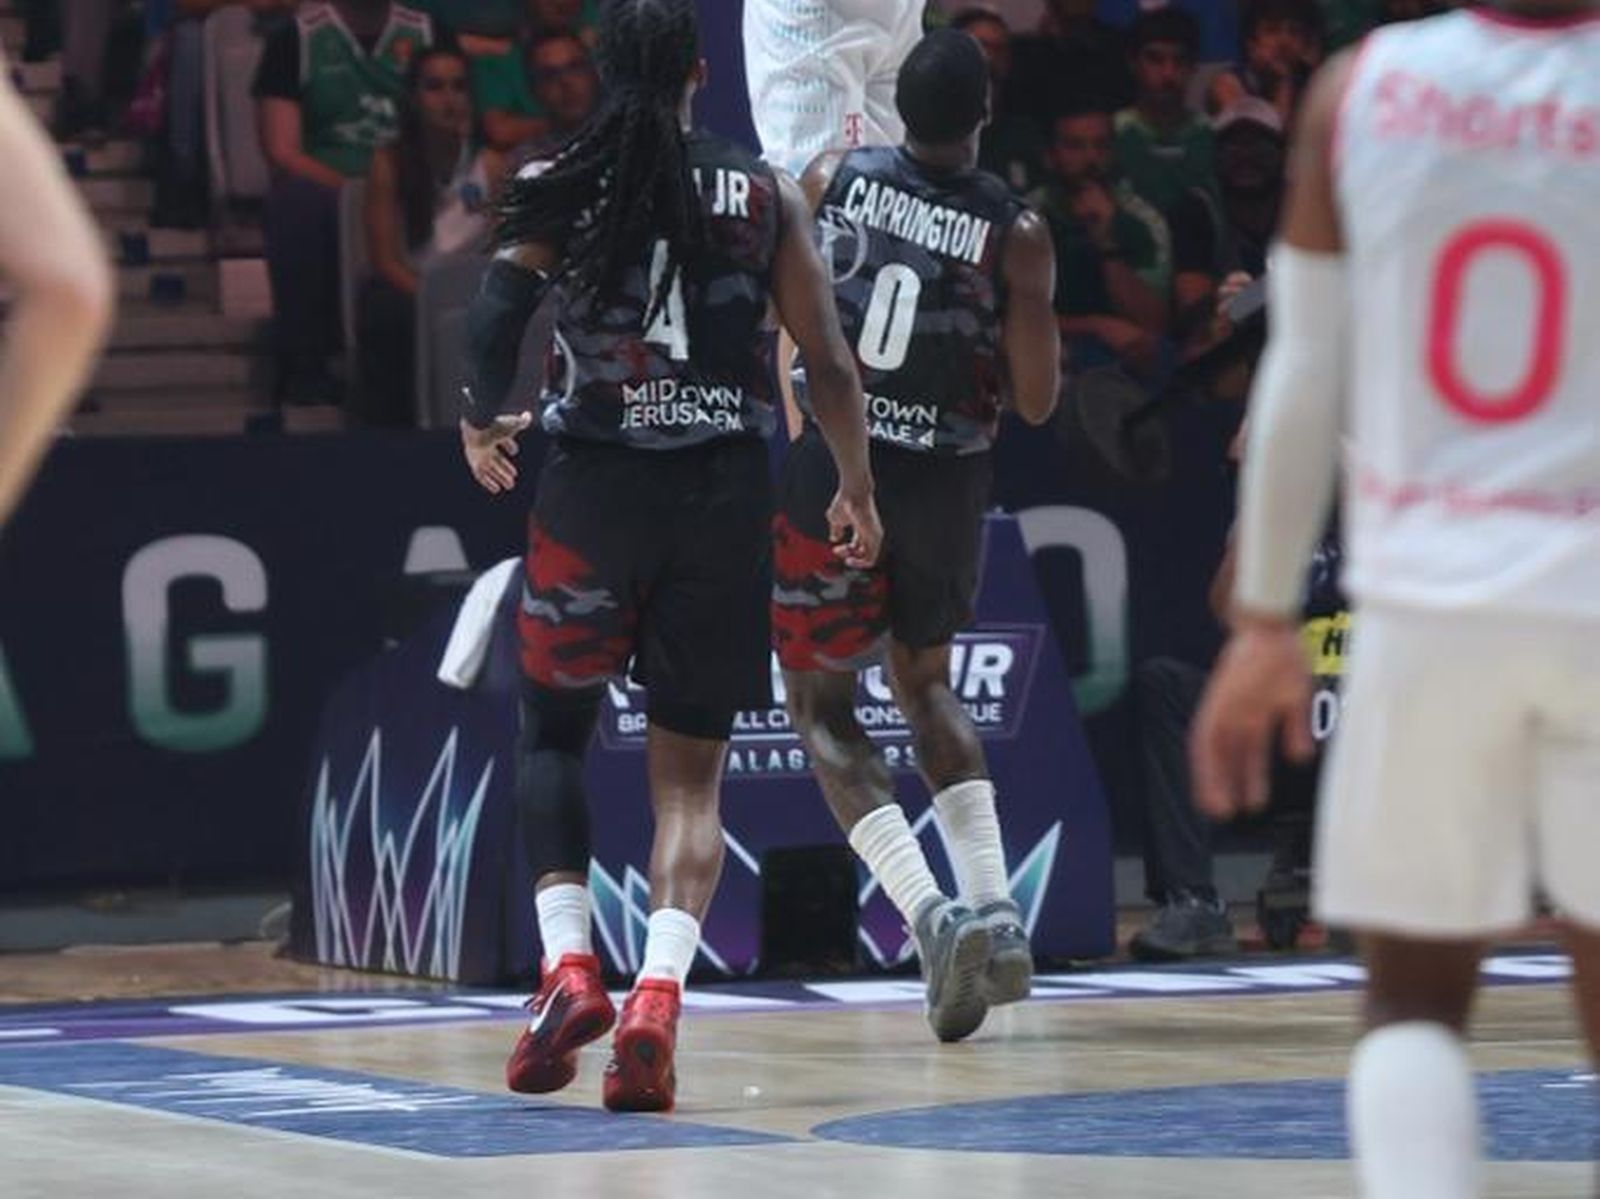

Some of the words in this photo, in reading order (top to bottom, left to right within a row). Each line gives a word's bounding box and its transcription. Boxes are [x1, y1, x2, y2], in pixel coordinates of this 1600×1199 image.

[712, 167, 750, 219] JR
[844, 176, 992, 264] CARRINGTON
[857, 263, 922, 372] 0
[1426, 211, 1572, 427] 0
[619, 401, 744, 432] JERUSAEM
[621, 379, 743, 409] MIDOWN
